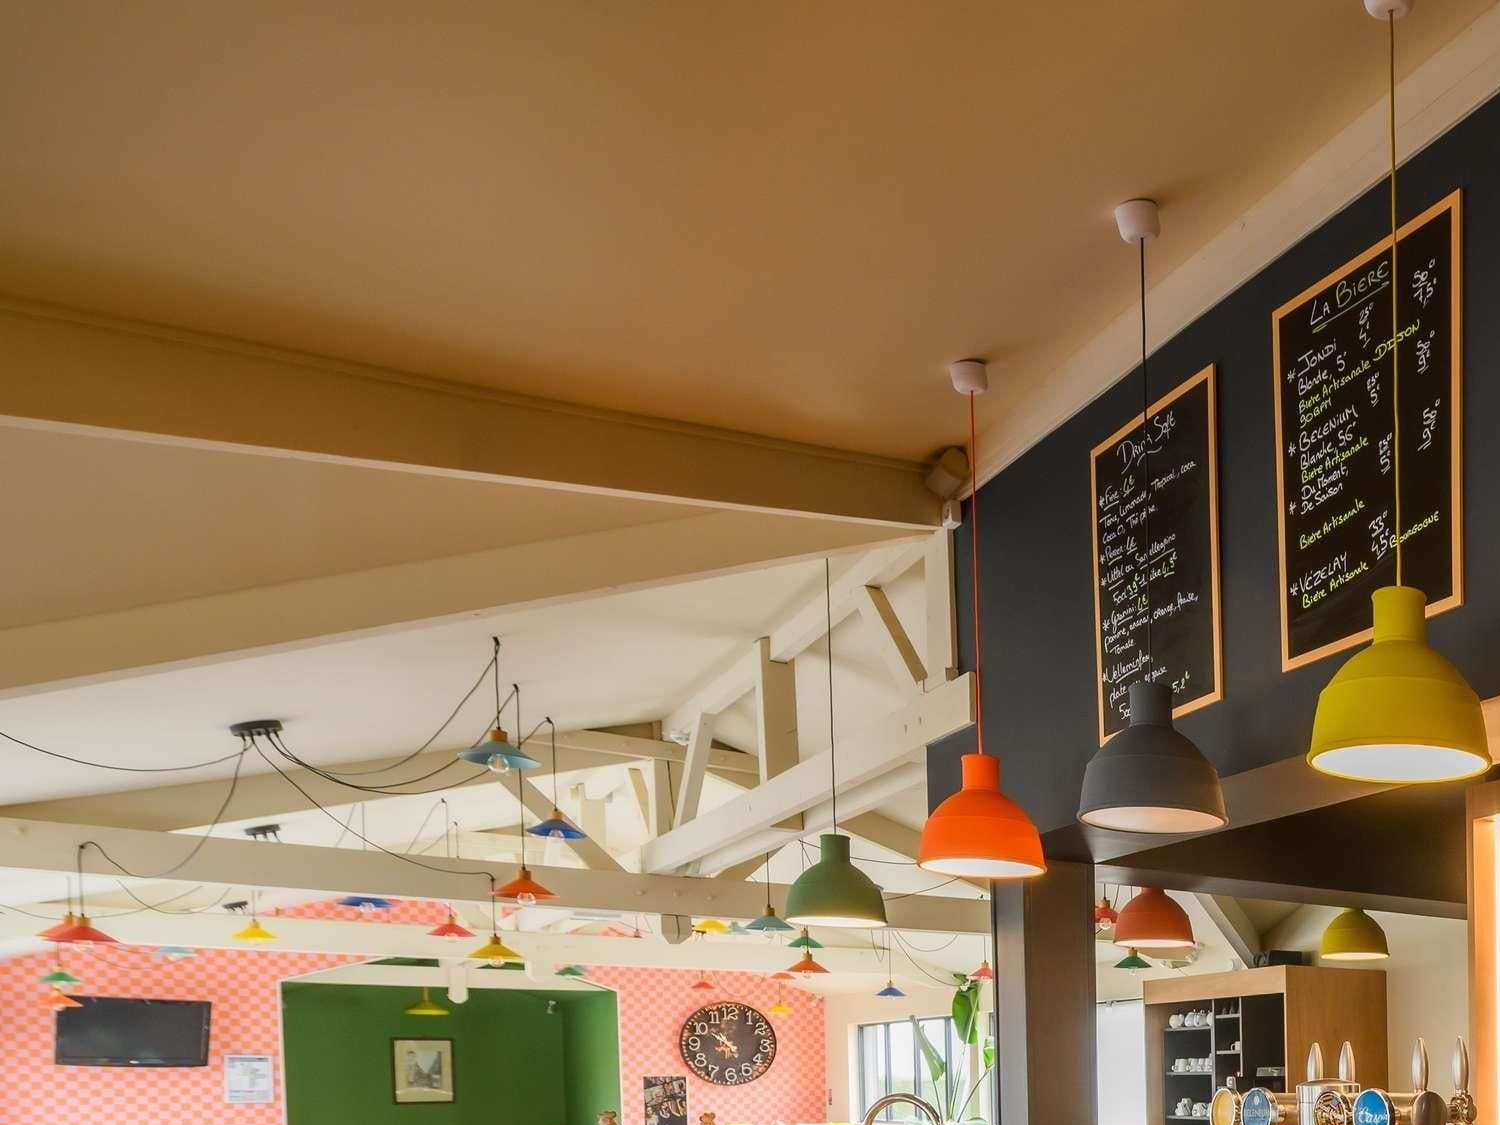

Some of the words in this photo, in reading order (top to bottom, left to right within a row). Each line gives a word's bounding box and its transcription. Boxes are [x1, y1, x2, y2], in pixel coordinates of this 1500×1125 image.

[708, 1010, 721, 1024] 11
[721, 1006, 739, 1021] 12
[745, 1009, 753, 1025] 1
[693, 1021, 708, 1036] 10
[754, 1022, 767, 1036] 2
[688, 1036, 701, 1051] 9
[759, 1039, 770, 1053] 3
[694, 1052, 707, 1067] 8
[752, 1053, 763, 1065] 4
[708, 1063, 720, 1080] 7
[724, 1067, 738, 1082] 6
